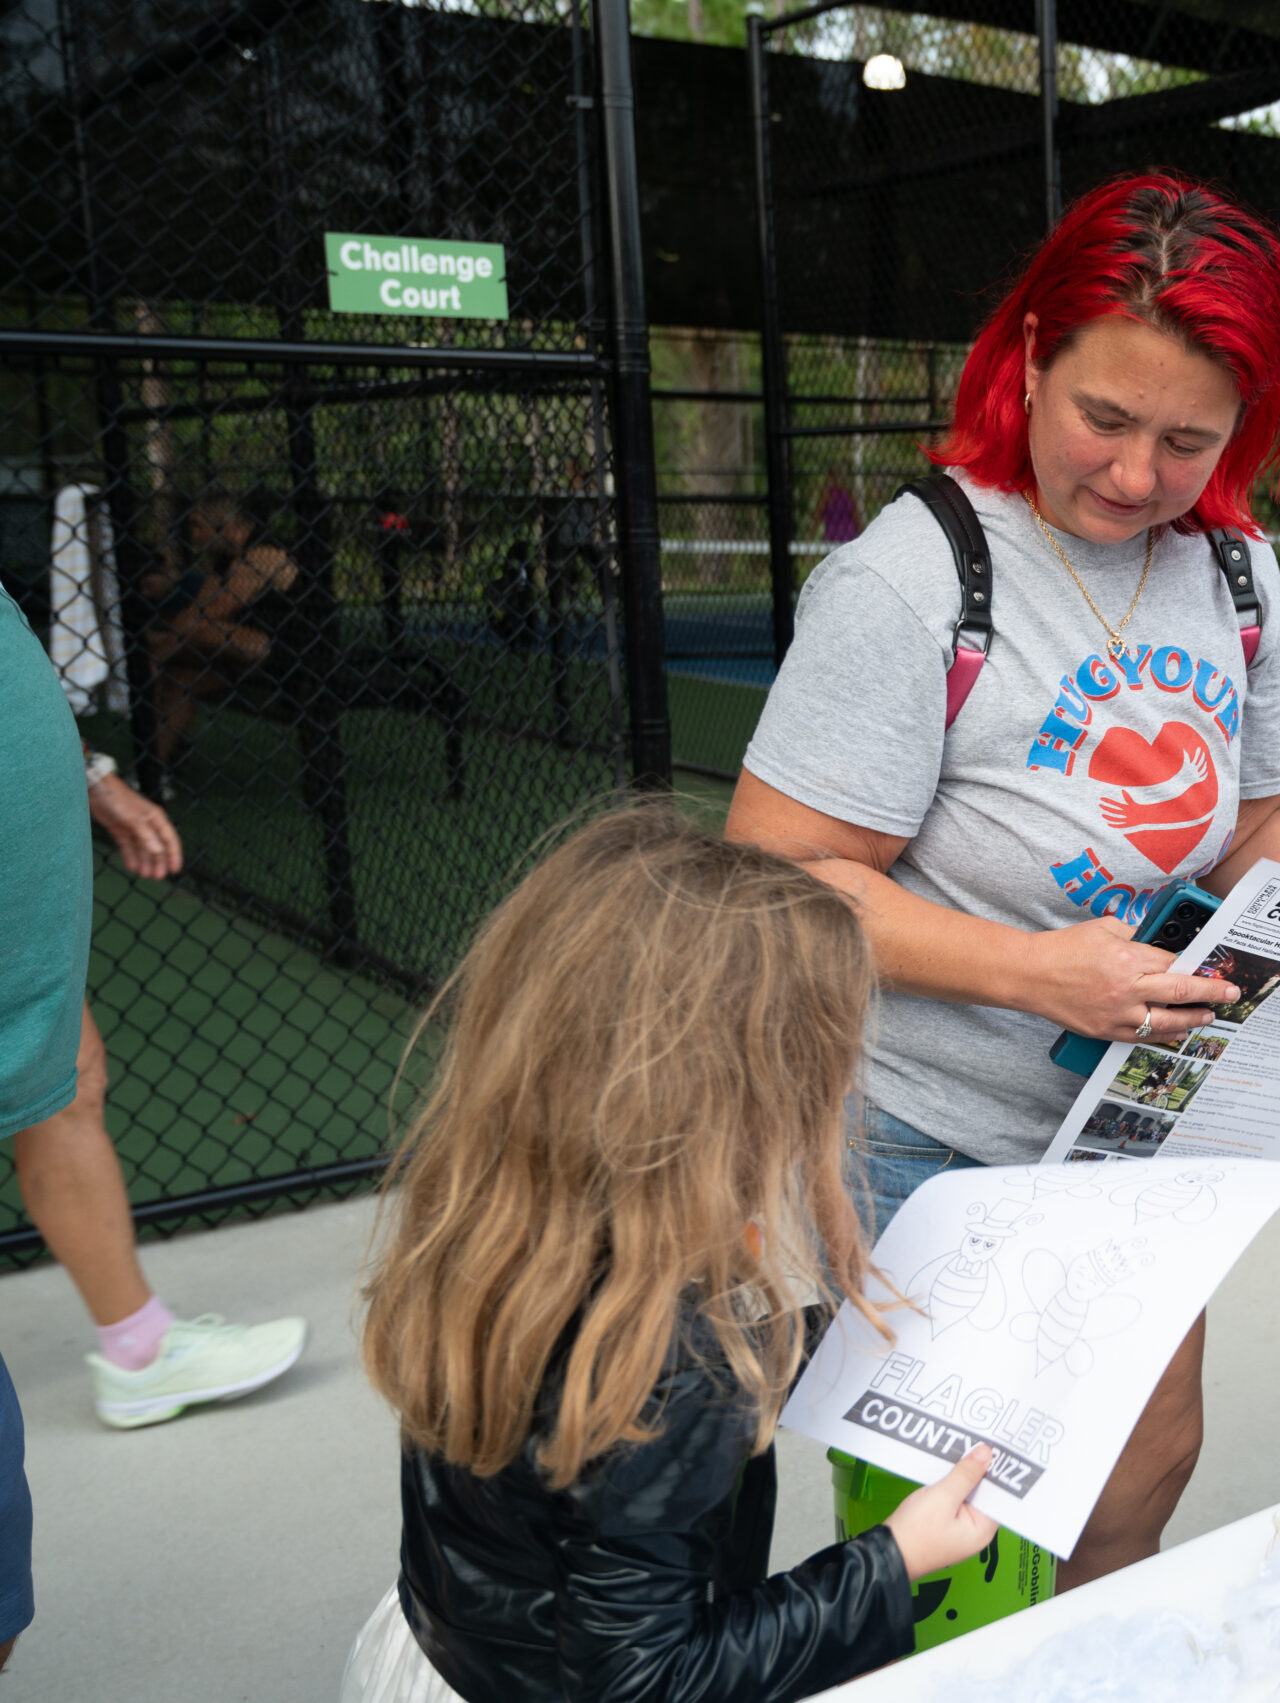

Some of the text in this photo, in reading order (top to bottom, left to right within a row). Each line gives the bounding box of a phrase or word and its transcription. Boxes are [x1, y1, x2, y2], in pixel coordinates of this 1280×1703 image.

[340, 240, 493, 282] Challenge
[379, 278, 462, 311] Court
[1228, 928, 1275, 946] Spooktacular
[860, 1398, 986, 1460] COUNTY
[869, 1351, 1065, 1464] FLAGLER
[1029, 1543, 1040, 1607] cGoblin
